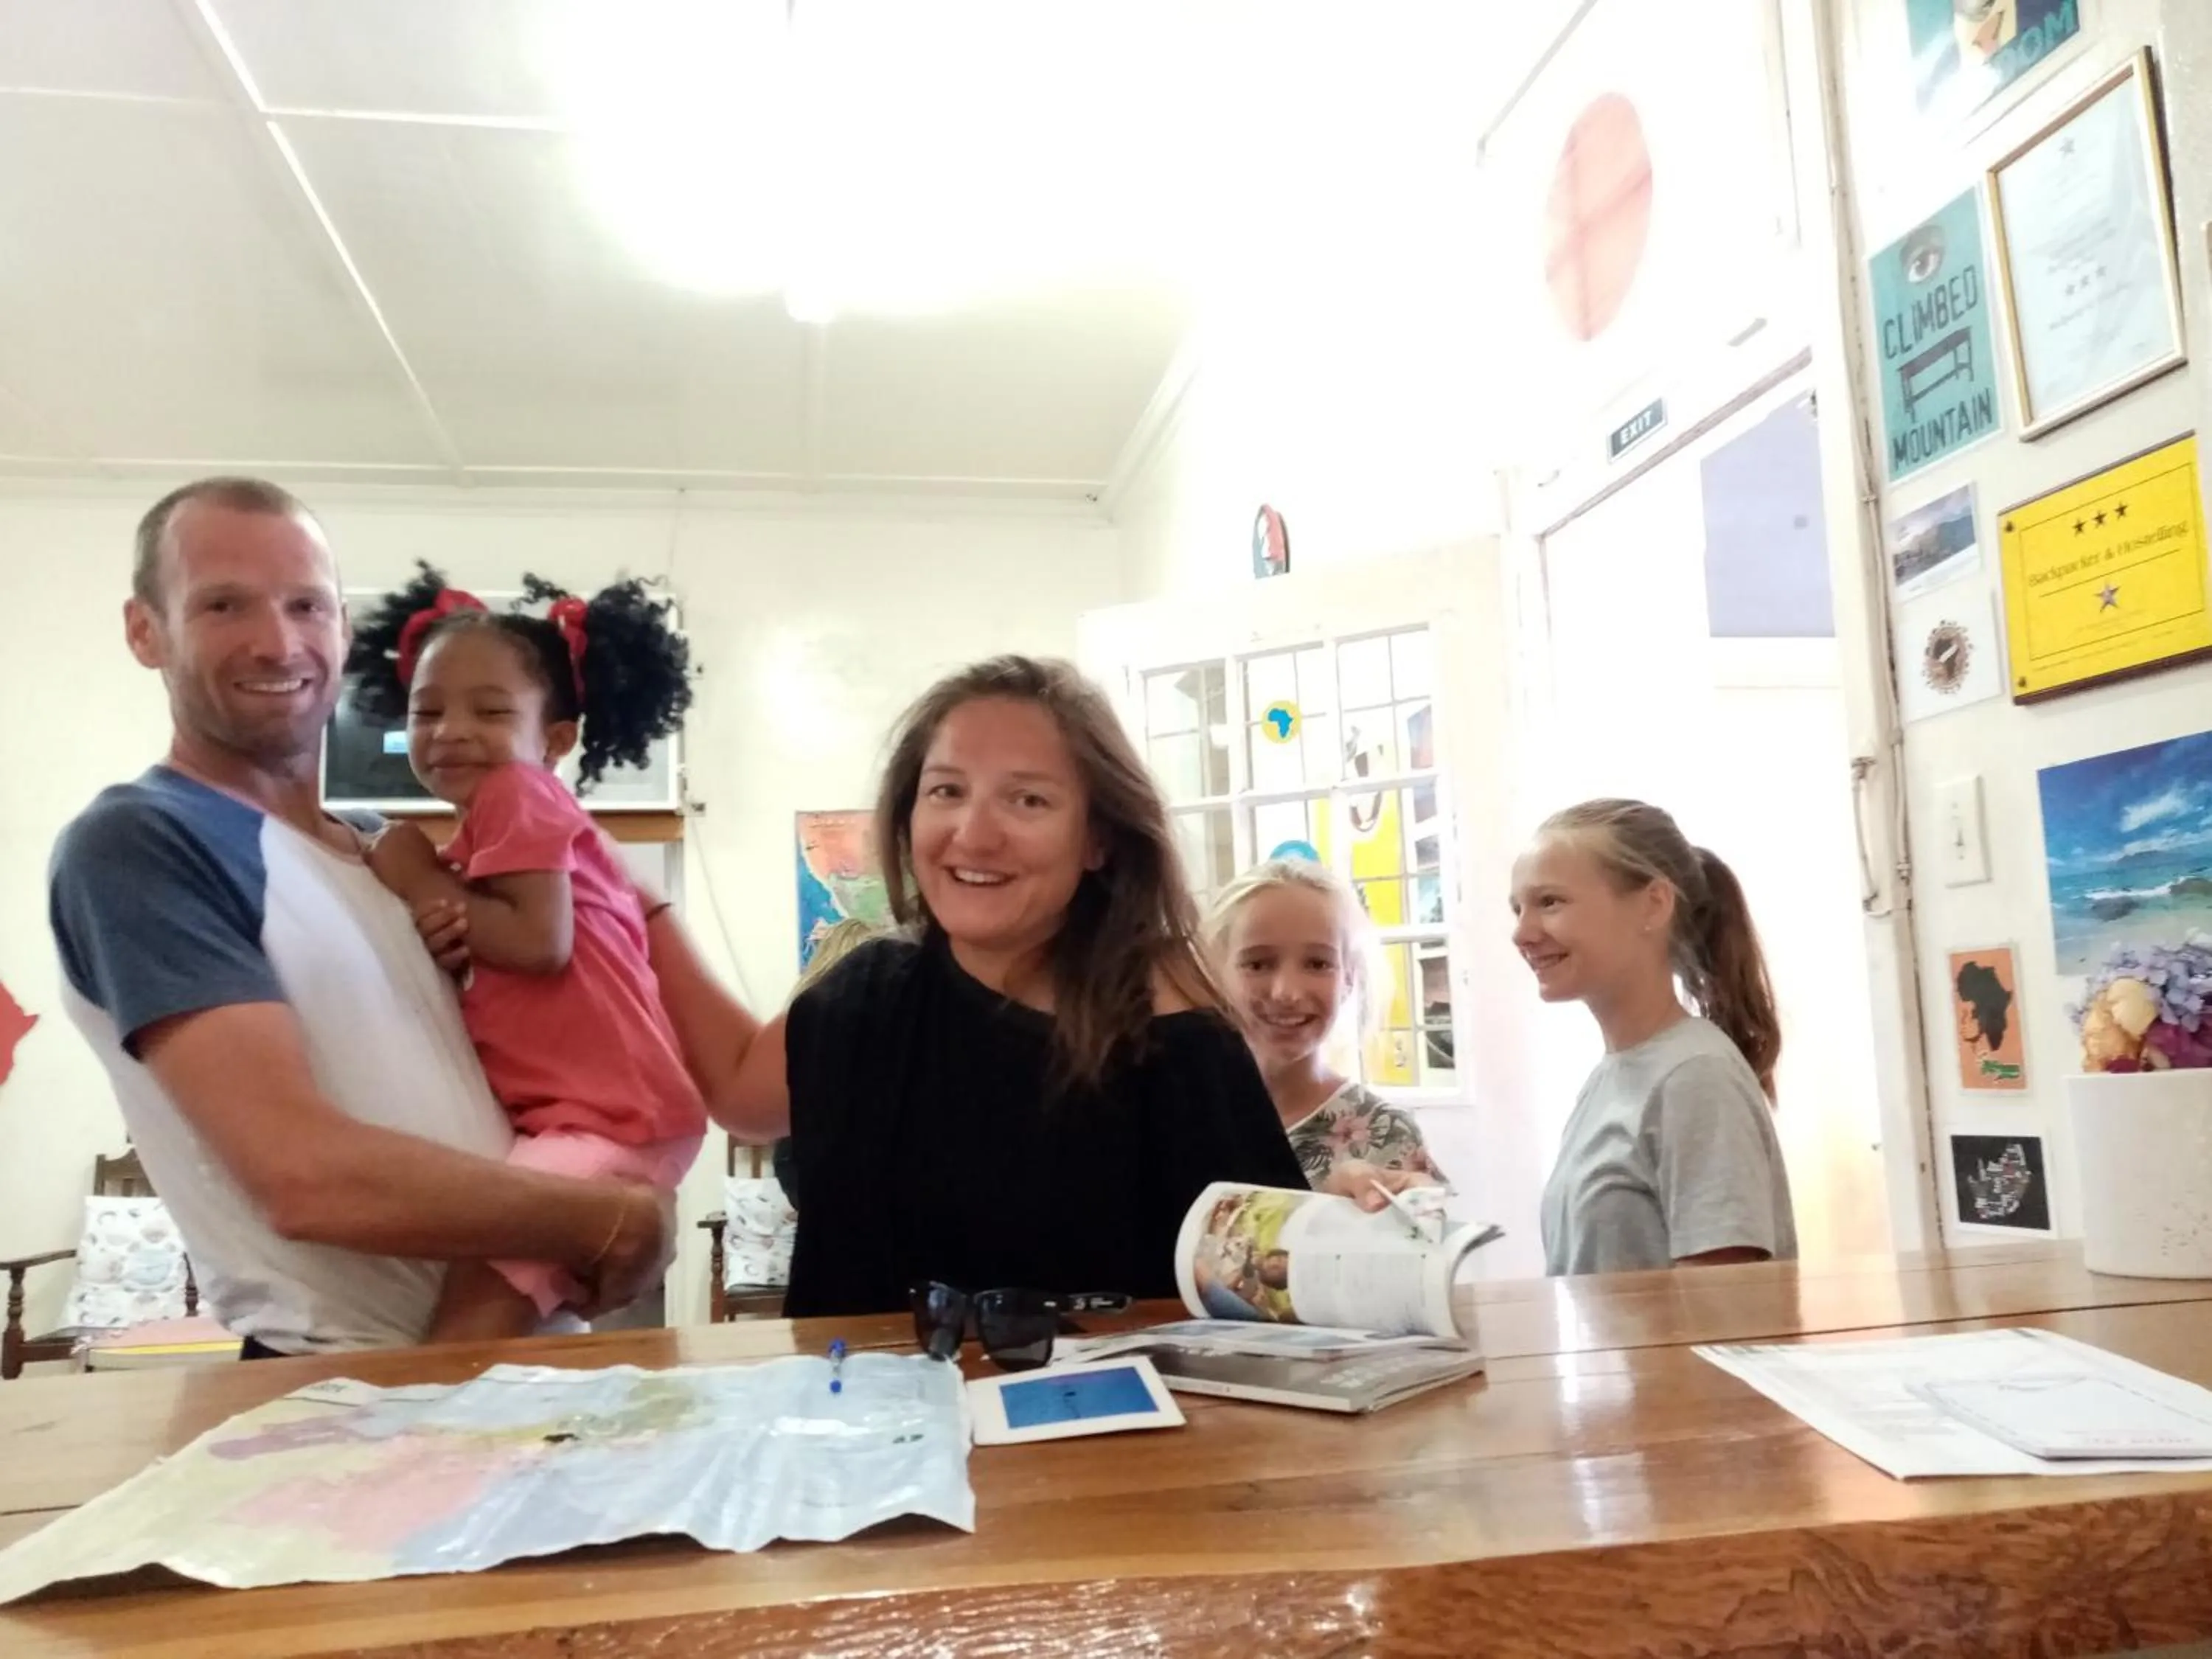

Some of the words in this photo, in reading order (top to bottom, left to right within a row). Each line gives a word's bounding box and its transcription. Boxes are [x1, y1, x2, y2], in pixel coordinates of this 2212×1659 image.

[1883, 265, 1978, 360] CLIMBED
[1621, 410, 1652, 445] EXIT
[1893, 387, 1992, 472] MOUNTAIN
